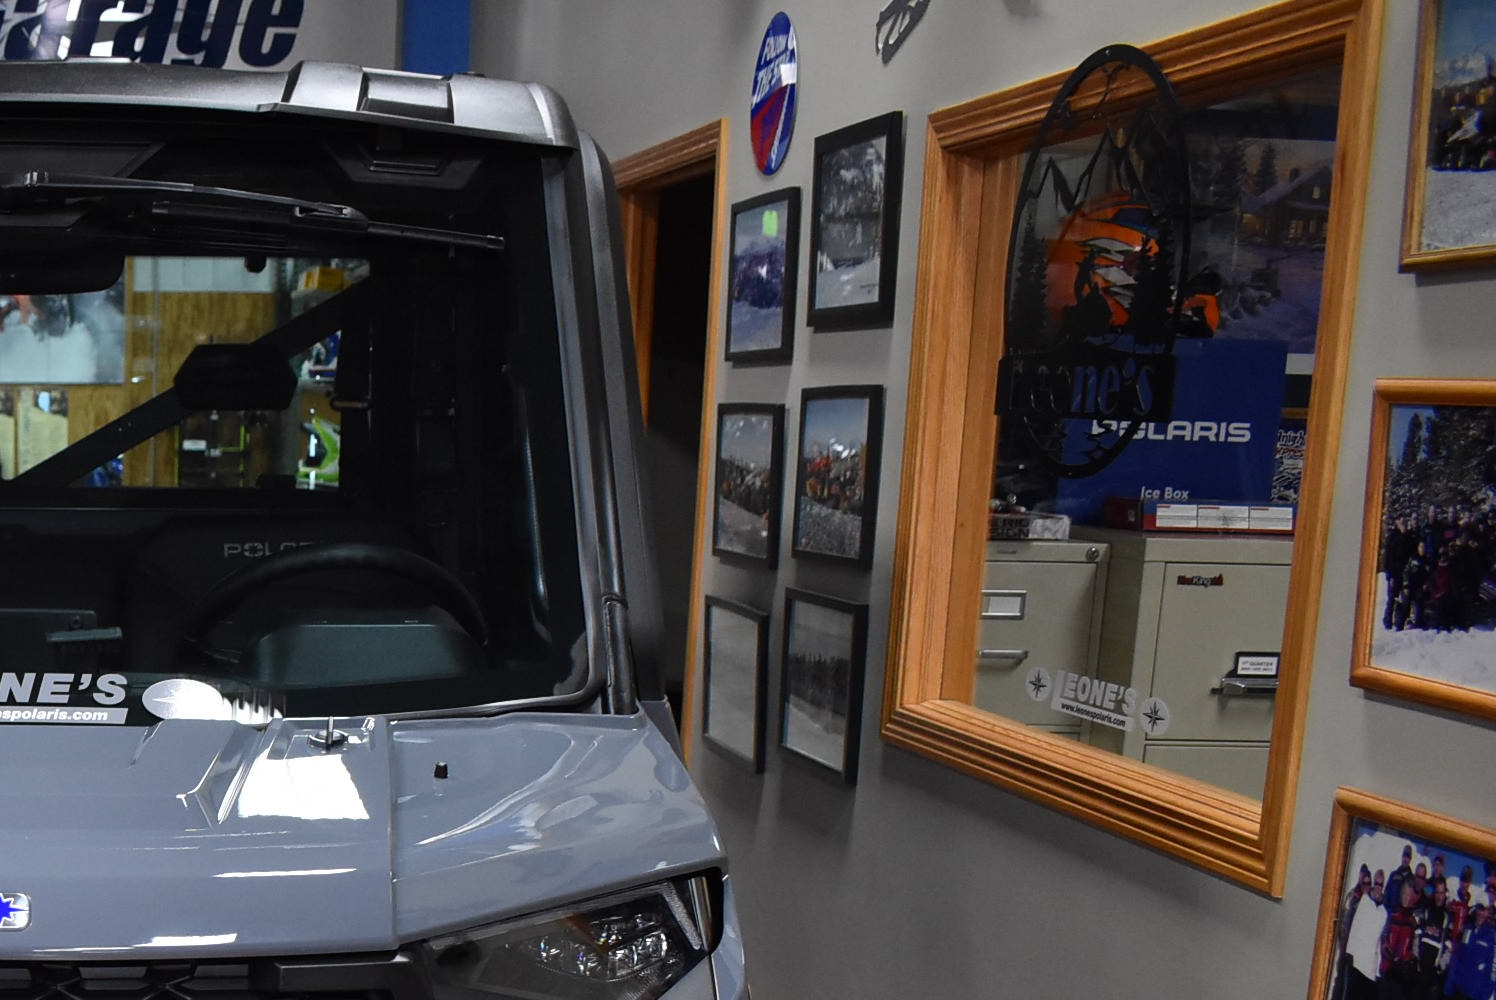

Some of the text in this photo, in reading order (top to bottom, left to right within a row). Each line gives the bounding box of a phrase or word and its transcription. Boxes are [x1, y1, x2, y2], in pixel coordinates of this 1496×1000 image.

[1141, 486, 1190, 501] Ice Box
[1052, 669, 1137, 714] LEONE'S
